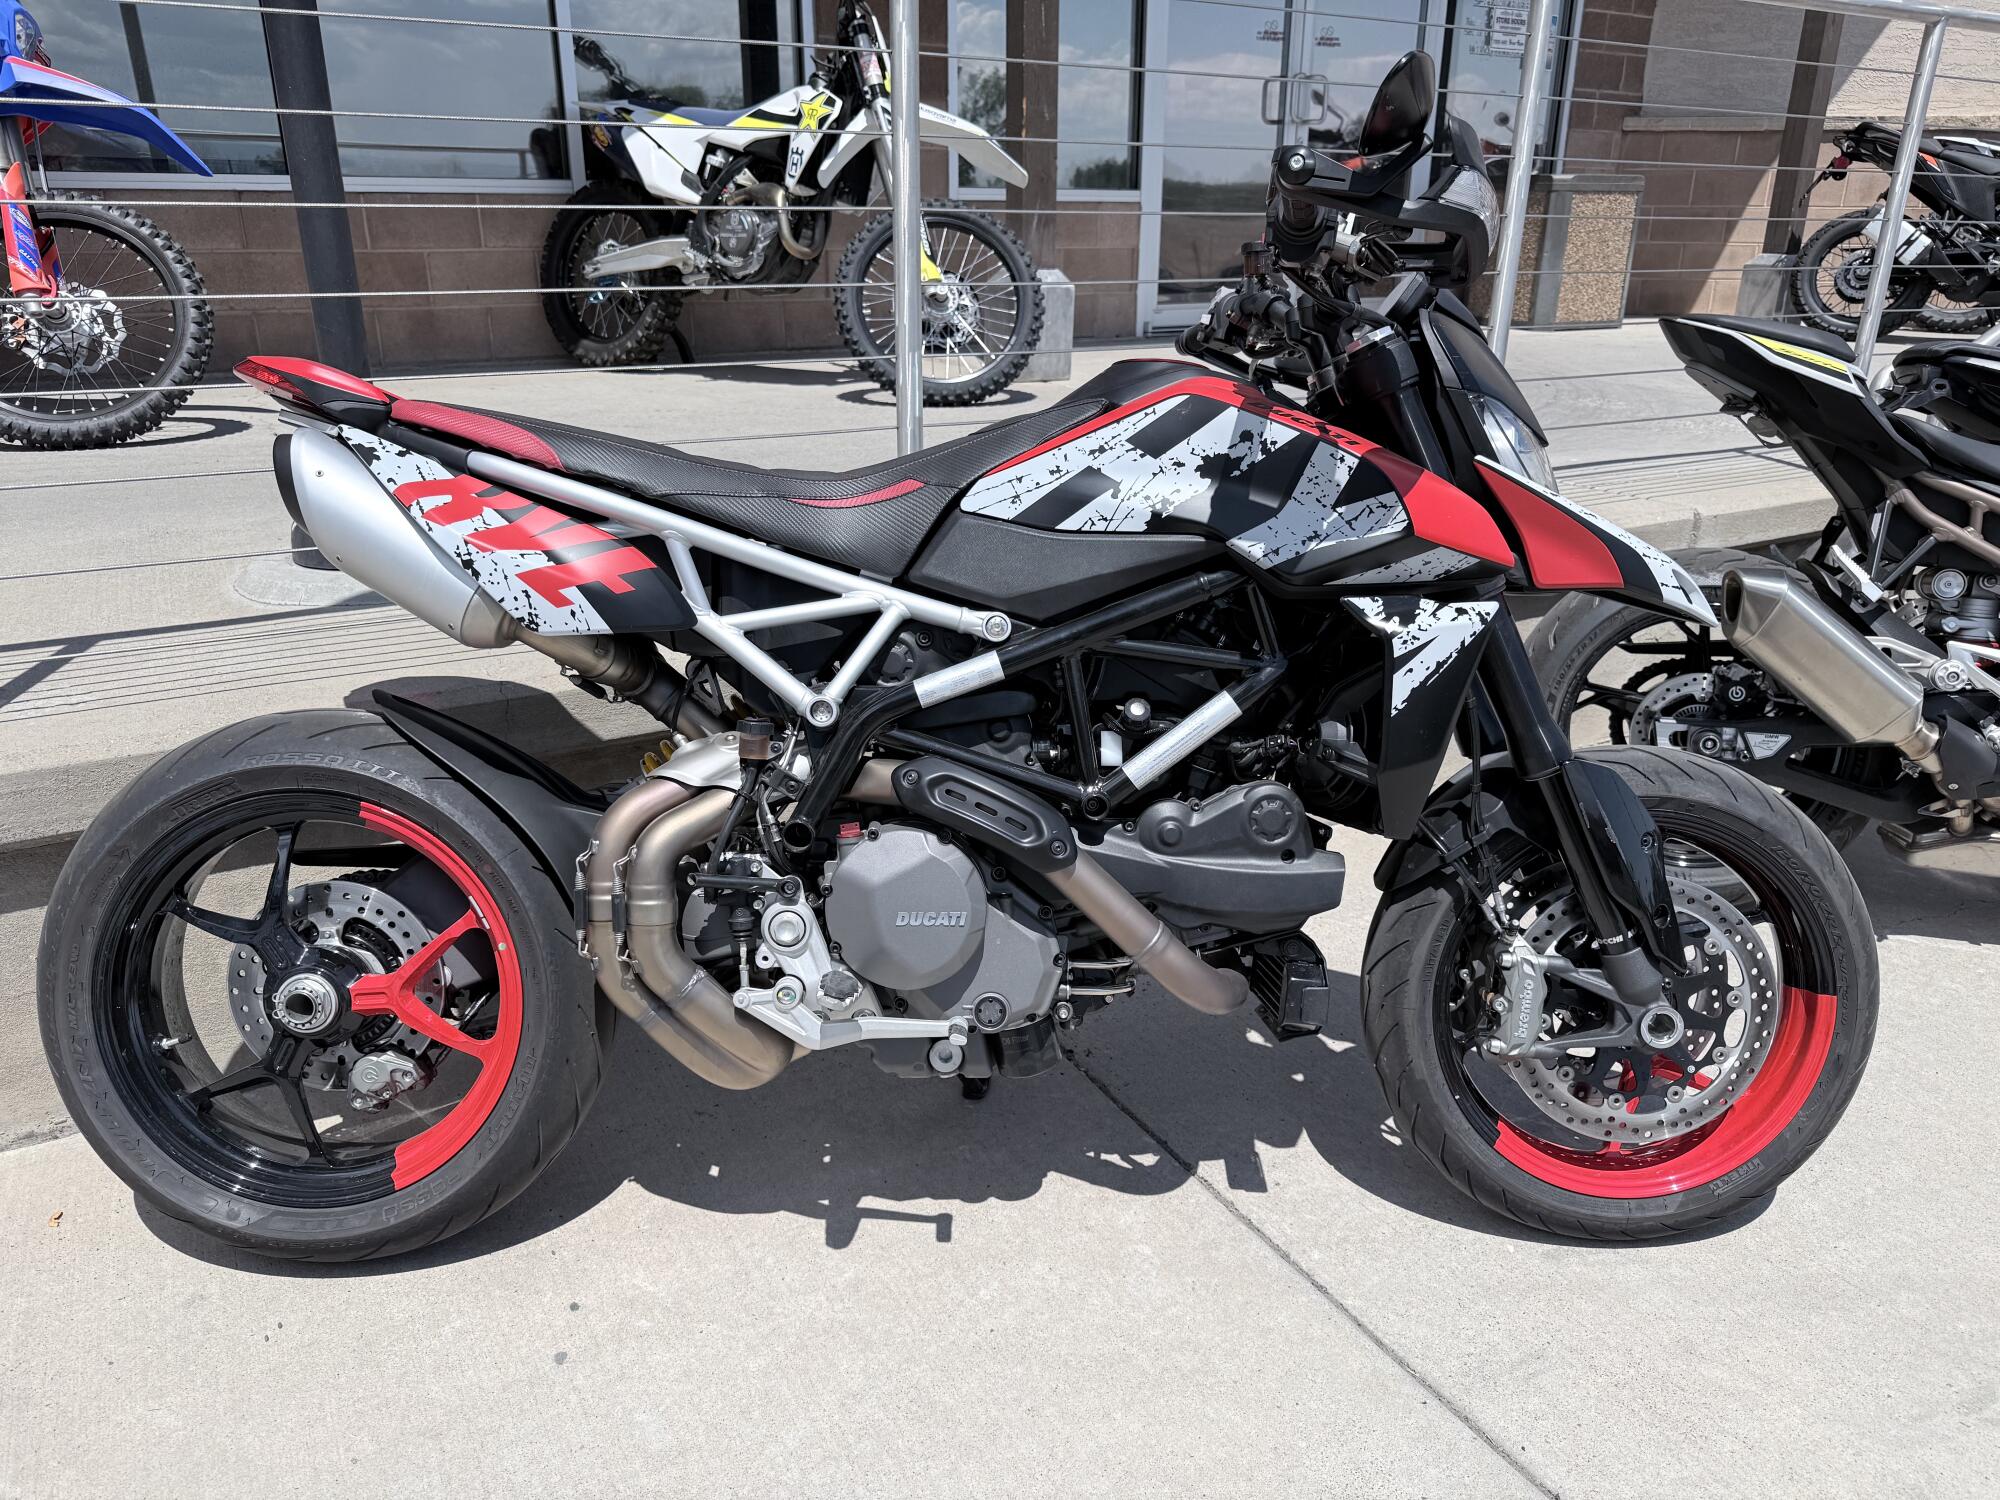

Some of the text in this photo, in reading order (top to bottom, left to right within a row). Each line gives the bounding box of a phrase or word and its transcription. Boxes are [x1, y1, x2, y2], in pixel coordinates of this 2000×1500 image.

[1247, 401, 1361, 446] DUCATI
[349, 758, 402, 781] III
[895, 911, 968, 928] DUCATI
[1518, 979, 1534, 1038] brembo
